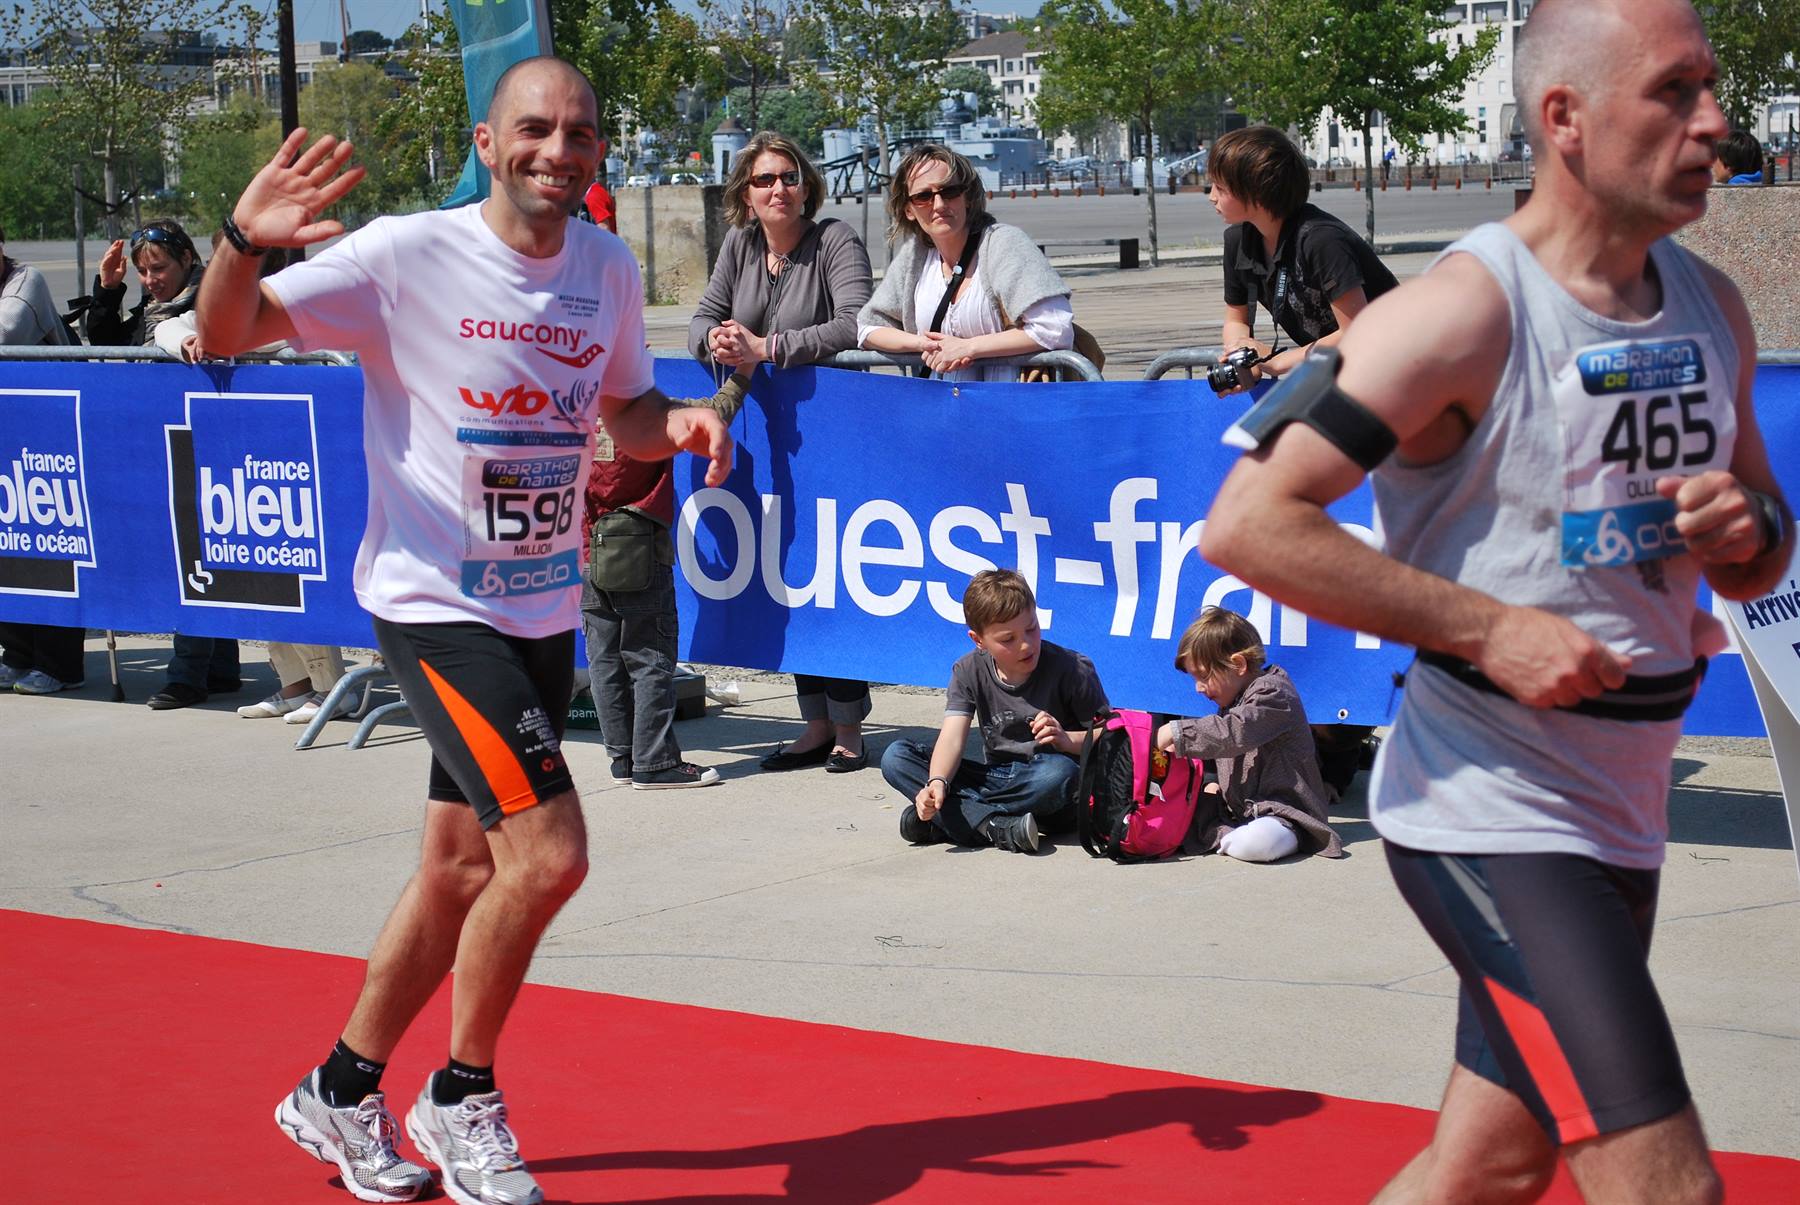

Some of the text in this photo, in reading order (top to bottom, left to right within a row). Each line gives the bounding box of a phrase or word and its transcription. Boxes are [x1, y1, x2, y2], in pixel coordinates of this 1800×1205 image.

[459, 318, 581, 352] saucony
[1602, 390, 1717, 474] 465
[22, 447, 76, 474] france
[244, 454, 310, 481] france
[200, 466, 315, 539] bleu
[483, 487, 576, 541] 1598
[0, 526, 88, 555] oire océan
[205, 538, 317, 567] loire océan
[514, 544, 552, 556] MILLION
[509, 563, 569, 589] odlo
